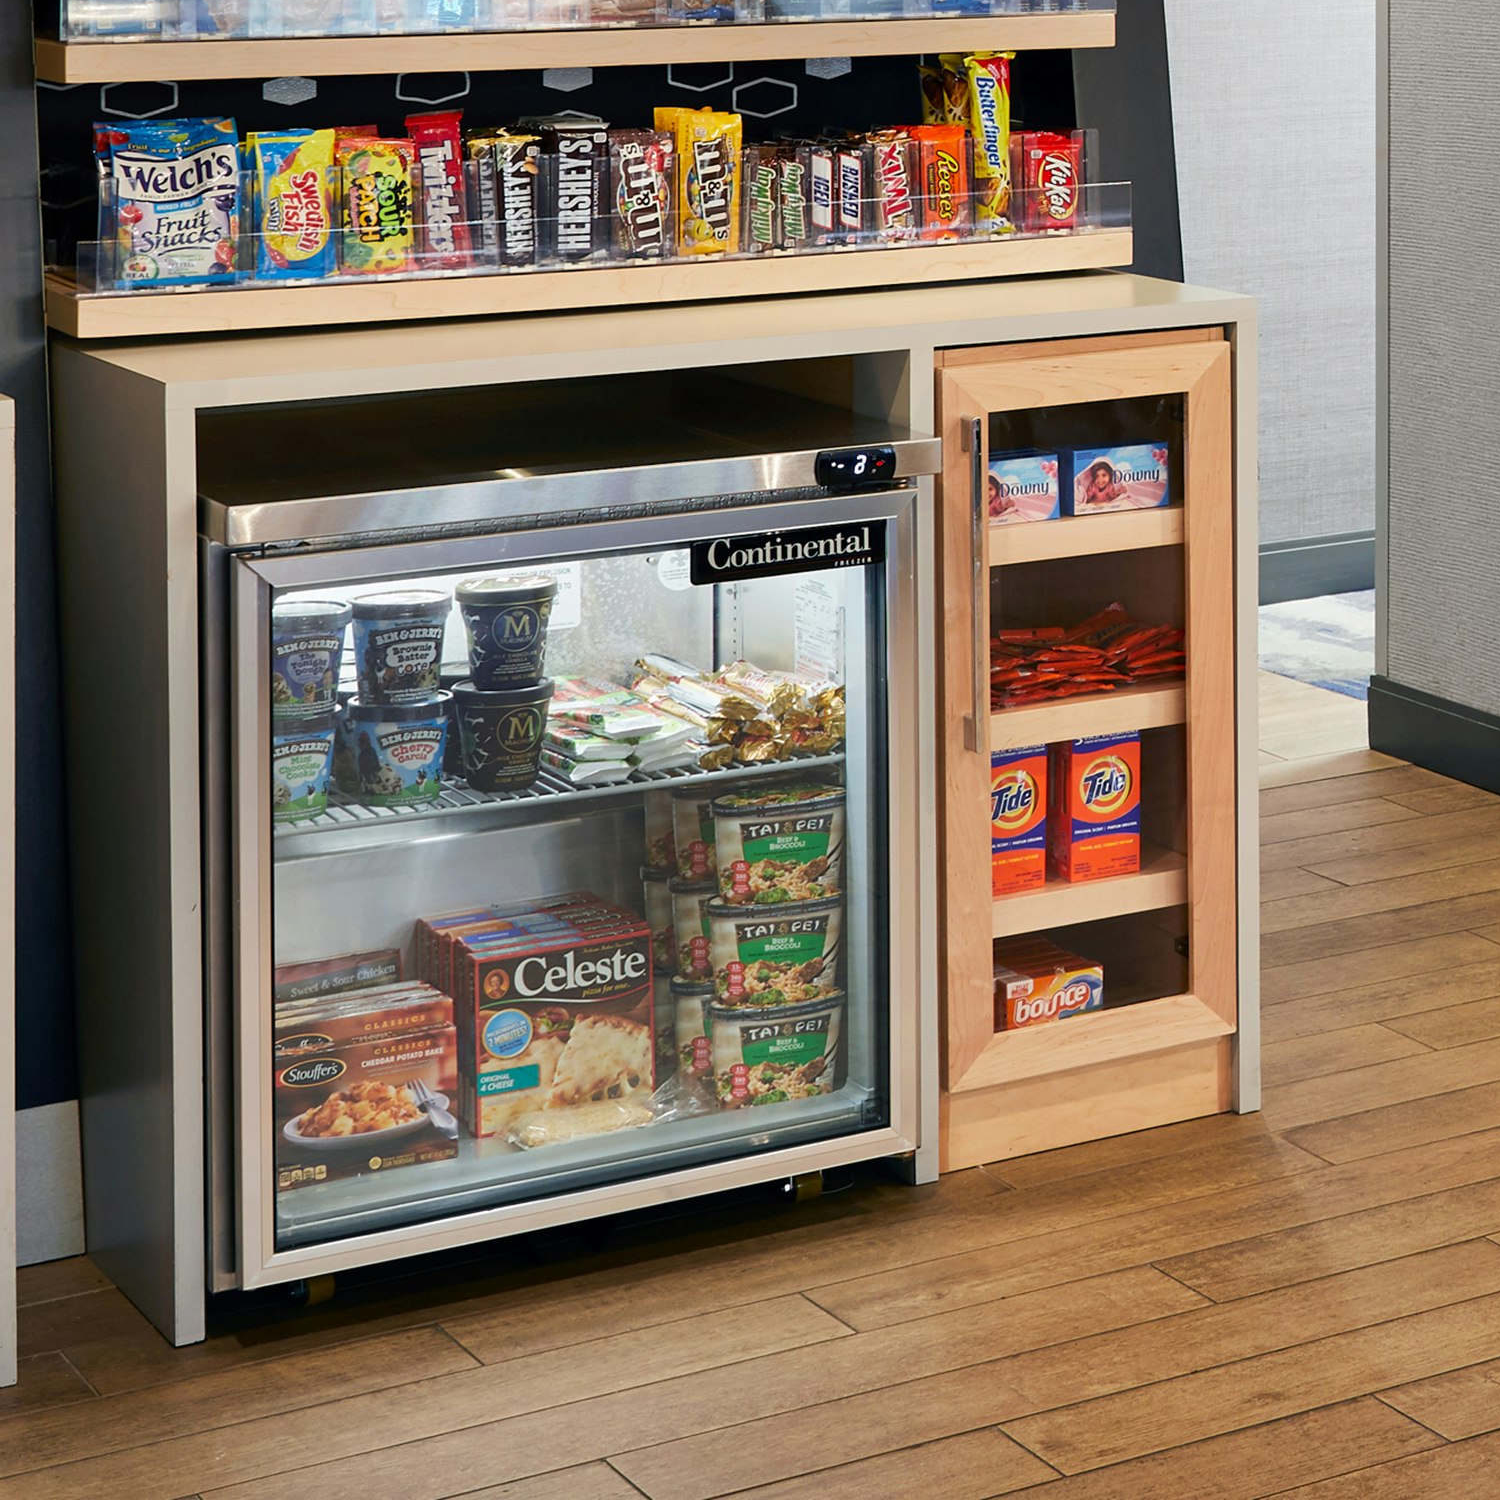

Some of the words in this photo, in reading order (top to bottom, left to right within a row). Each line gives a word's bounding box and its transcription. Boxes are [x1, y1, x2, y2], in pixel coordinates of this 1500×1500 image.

[975, 76, 1001, 169] Butterfinger
[127, 143, 148, 151] Fruit
[120, 151, 233, 194] Welch's
[814, 174, 830, 208] ICED
[842, 164, 859, 218] RUSHED
[935, 151, 960, 221] Reese's
[558, 140, 593, 251] HERSHEY'S
[281, 192, 302, 236] Fish
[290, 169, 324, 253] Swedish
[353, 175, 382, 243] PATCH
[376, 175, 402, 238] SOUR
[504, 159, 532, 256] HERSHEY'S
[156, 209, 210, 235] Fruit
[140, 226, 222, 254] Snacks
[1112, 468, 1160, 484] Downy
[1000, 481, 1050, 498] Downy
[707, 527, 872, 570] Continental
[834, 556, 873, 567] FREEZER
[504, 615, 531, 637] M
[375, 631, 400, 645] BEN
[409, 627, 443, 640] JERRY'S
[276, 642, 299, 655] BEN
[308, 639, 340, 651] JERRY'S
[391, 643, 433, 655] Brownie
[290, 658, 328, 670] Tonight
[298, 653, 316, 661] The
[397, 652, 430, 663] Batter
[294, 666, 324, 676] Dough
[508, 716, 534, 742] M
[299, 742, 330, 753] JERRY'S
[380, 736, 403, 747] BEN
[410, 731, 442, 743] JERRY'S
[291, 755, 312, 764] Mint
[391, 743, 435, 758] Cherry
[398, 754, 428, 764] Garcia
[278, 762, 321, 775] Chocolate
[1083, 768, 1126, 805] Tide
[991, 783, 1033, 821] Tide
[749, 822, 779, 838] TAI
[795, 818, 824, 831] PEI
[769, 840, 806, 850] BROCCOLI
[776, 836, 793, 844] BEEF
[744, 923, 775, 938] TAI
[791, 920, 820, 932] PEI
[764, 942, 801, 952] BROCCOLI
[290, 984, 319, 999] Sweet
[321, 979, 330, 989] &
[331, 974, 356, 987] Sour
[356, 964, 396, 980] Chicken
[513, 949, 647, 997] Celeste
[582, 987, 602, 998] pizza
[602, 984, 614, 996] for
[1015, 985, 1087, 1023] bounce
[364, 1013, 427, 1031] CLASSICS
[749, 1026, 780, 1041] TAI
[795, 1019, 823, 1032] PEI
[374, 1039, 432, 1055] CLASSICS
[769, 1043, 804, 1053] BROCCOLI
[360, 1054, 396, 1068] CHEDDAR
[396, 1050, 424, 1062] POTATO
[424, 1046, 445, 1058] BAKE
[287, 1062, 338, 1083] Stouffer's
[480, 1073, 510, 1085] ORIGINAL
[480, 1083, 487, 1092] 4
[487, 1079, 515, 1092] CHEESE
